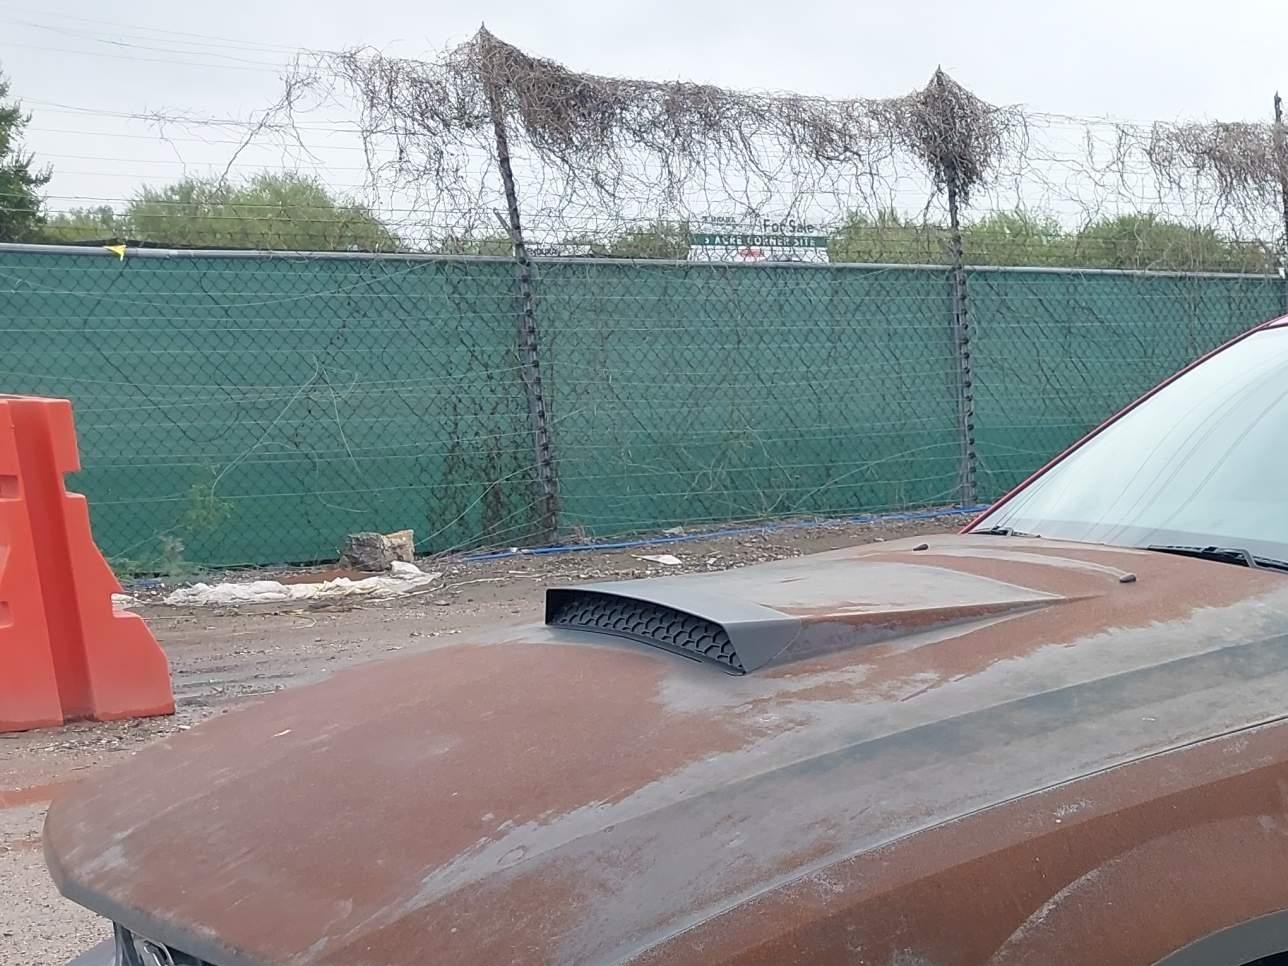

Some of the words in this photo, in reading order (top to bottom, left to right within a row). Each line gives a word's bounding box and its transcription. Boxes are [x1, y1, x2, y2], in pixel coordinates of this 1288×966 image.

[763, 219, 786, 233] For
[789, 219, 815, 233] Sale
[714, 235, 742, 245] ACRE
[747, 236, 788, 246] CORNER
[793, 237, 816, 247] SITE
